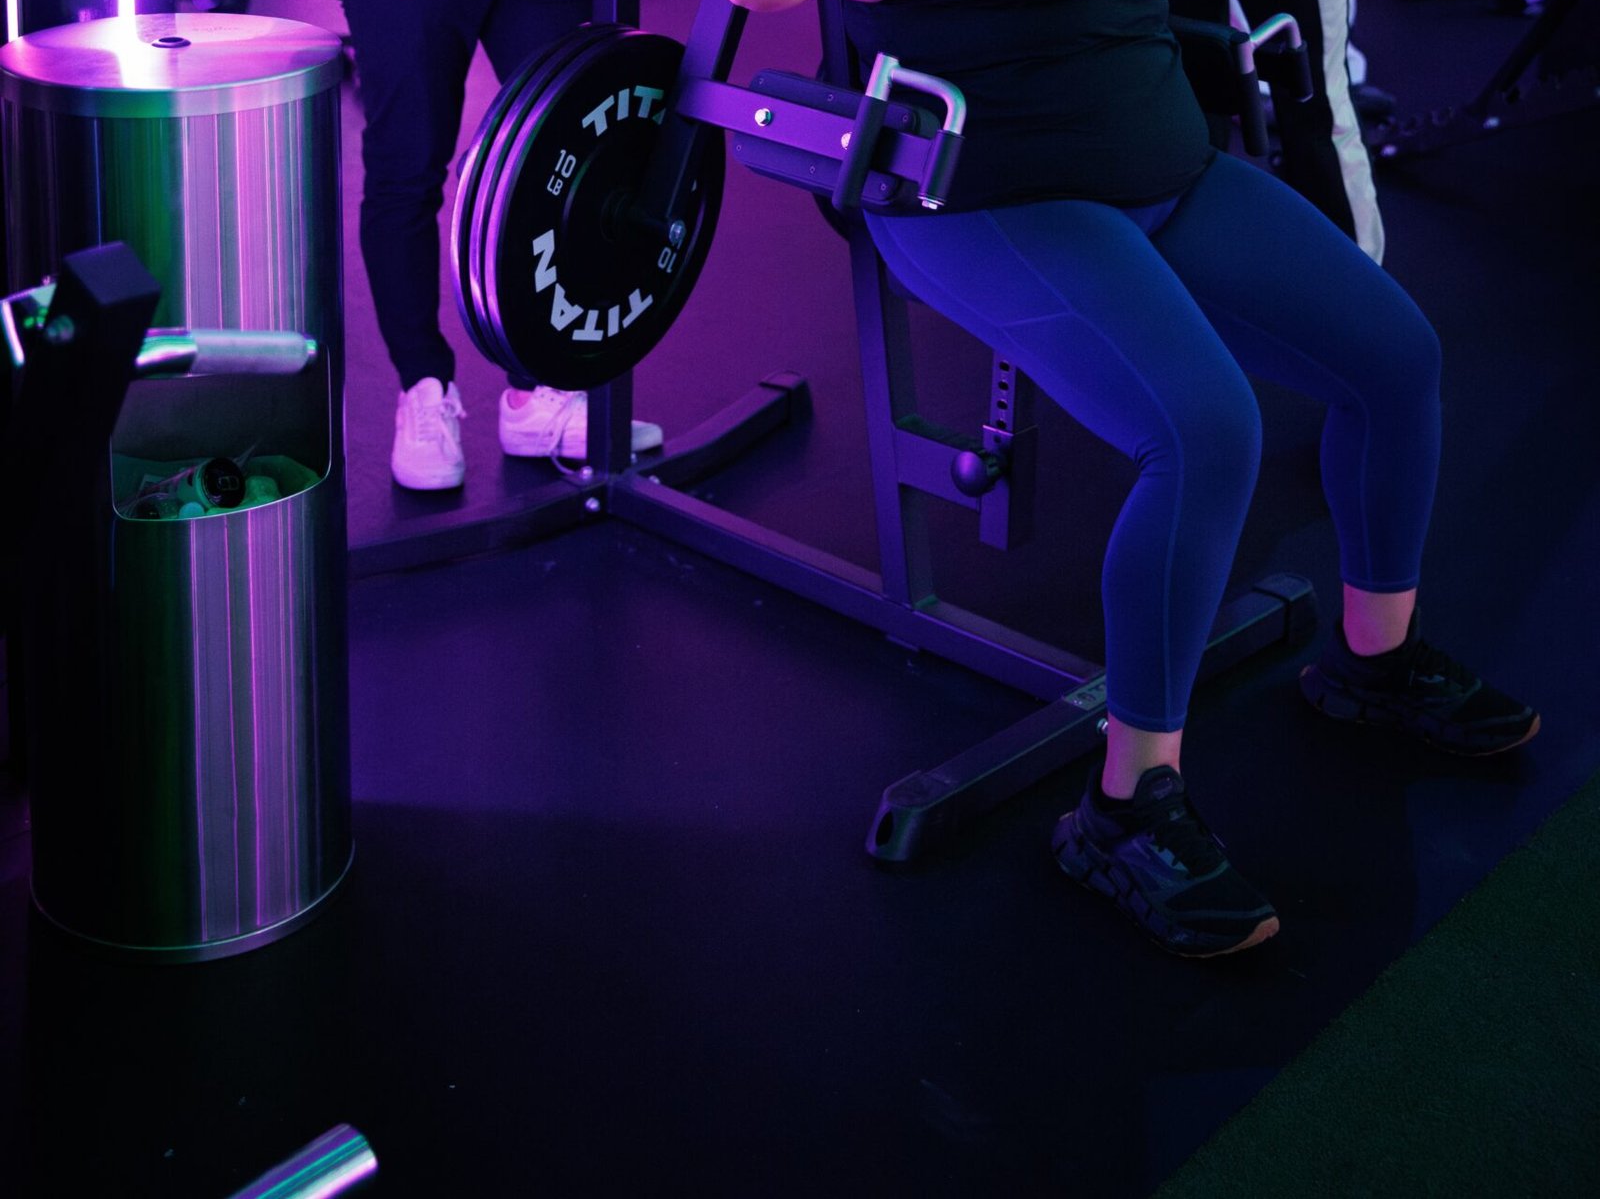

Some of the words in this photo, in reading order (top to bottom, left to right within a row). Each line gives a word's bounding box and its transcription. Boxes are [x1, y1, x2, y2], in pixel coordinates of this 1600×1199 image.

[582, 85, 667, 137] TIT
[555, 149, 577, 179] 10
[546, 175, 564, 196] LB
[657, 246, 678, 274] 10
[532, 229, 654, 342] TITAN
